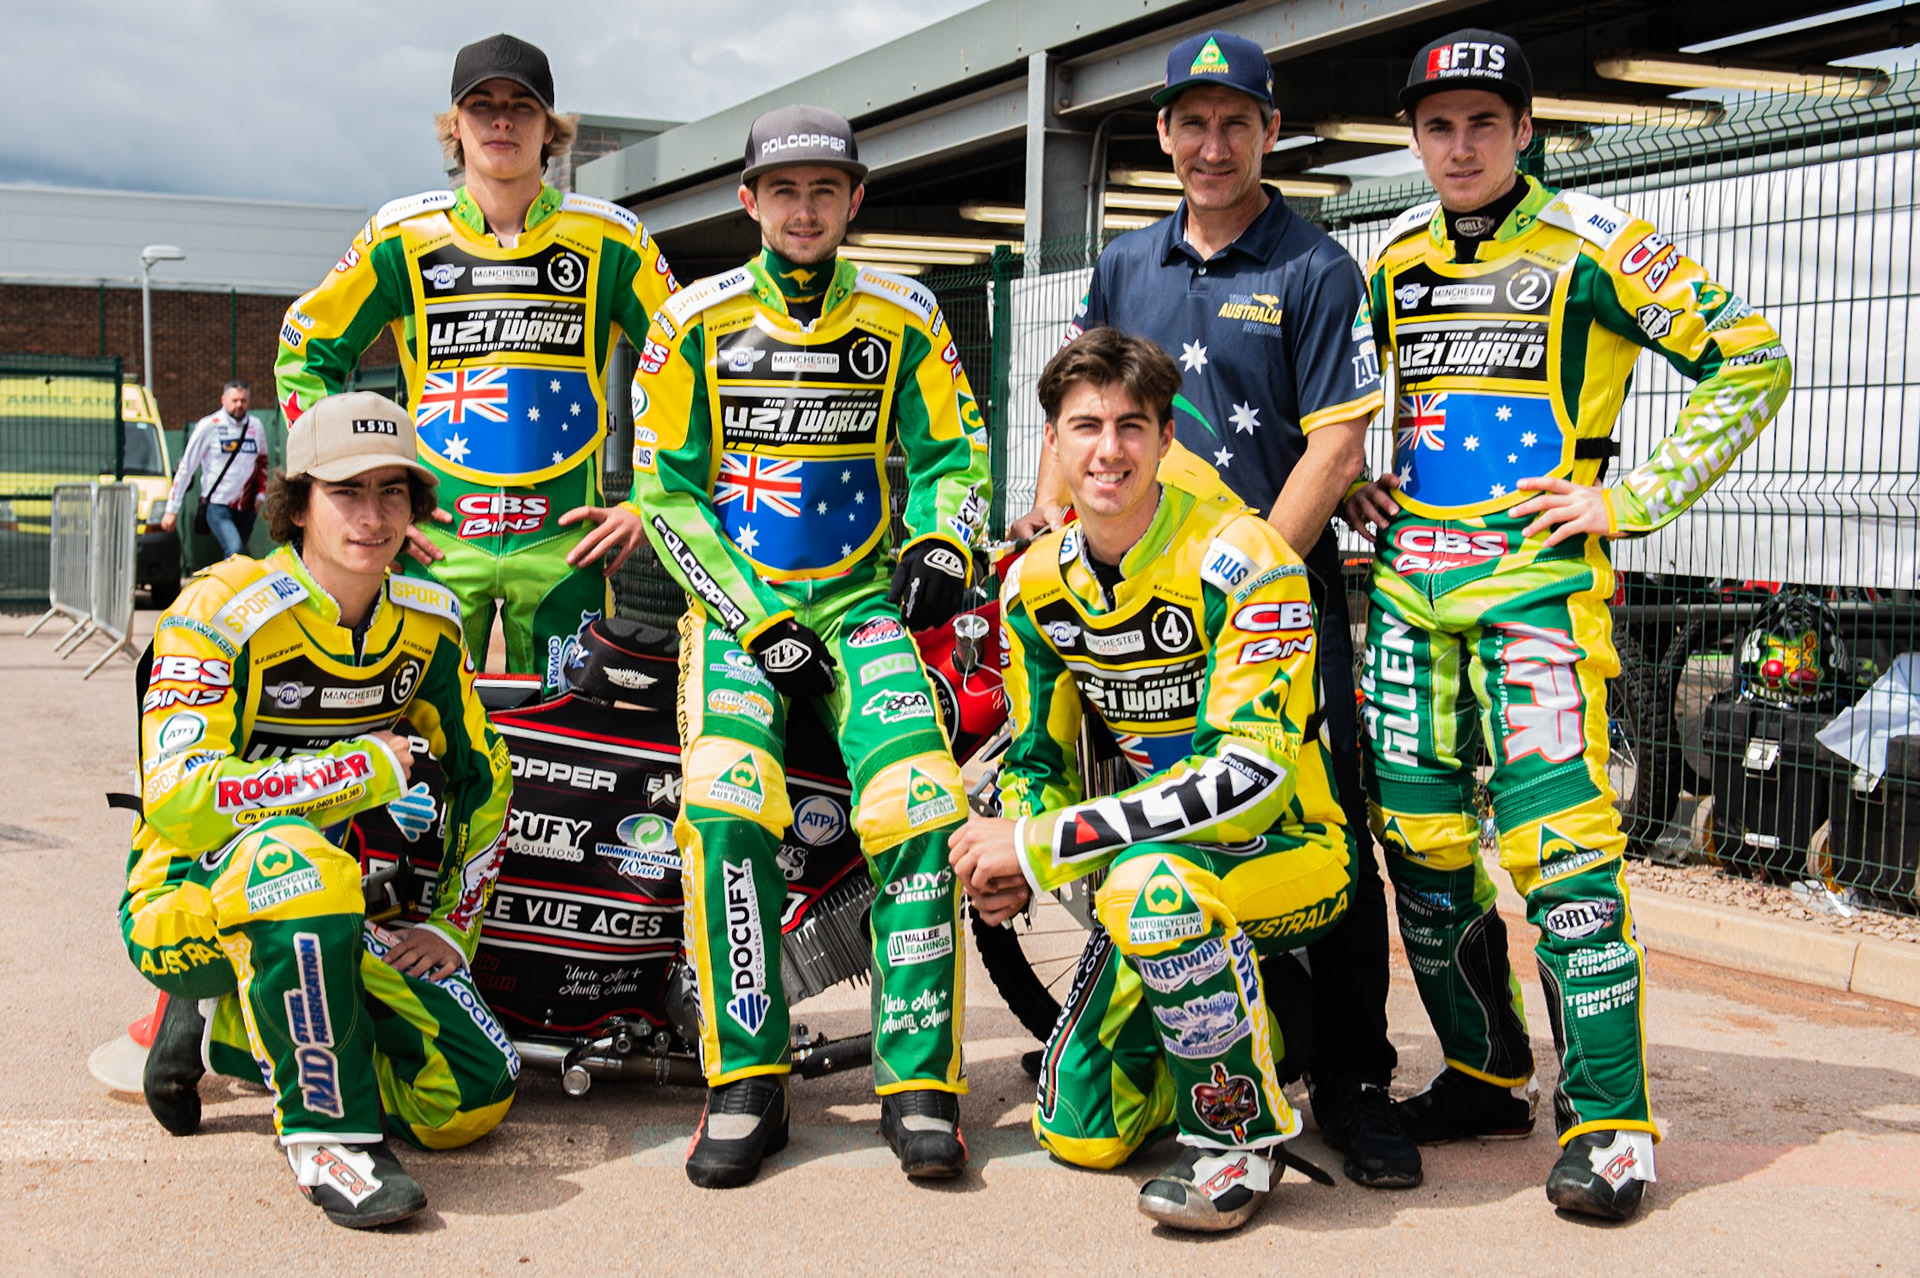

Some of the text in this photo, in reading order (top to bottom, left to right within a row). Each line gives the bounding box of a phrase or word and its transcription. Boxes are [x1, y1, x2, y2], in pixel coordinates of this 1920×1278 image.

[1452, 42, 1505, 71] FTS
[1439, 68, 1469, 78] Training
[1470, 67, 1503, 79] Services
[762, 134, 847, 157] POLCOPPER
[473, 269, 536, 278] MANCHESTER
[558, 258, 575, 286] 3
[1517, 274, 1539, 303] 2
[1218, 303, 1282, 325] AUSTRALIA
[430, 319, 583, 347] U21 WORLD
[774, 355, 837, 364] MANCHESTER
[861, 344, 874, 373] 1
[1399, 342, 1446, 368] U21
[1445, 341, 1545, 369] WORLD
[725, 406, 877, 434] U21 WORLD
[1645, 390, 1770, 524] KNIGHT
[458, 495, 548, 516] CBS
[461, 515, 541, 536] BINS
[1399, 530, 1505, 557] CBS
[655, 516, 746, 631] POLCOPPER
[1162, 613, 1183, 646] 4
[1233, 603, 1312, 631] CB
[549, 638, 559, 686] COWRA
[865, 656, 914, 680] DVR
[281, 690, 299, 701] FIM
[323, 686, 383, 701] MANCHESTER
[399, 668, 414, 697] 5
[1381, 611, 1419, 768] ALLEN
[219, 753, 369, 808] ROOF TILER
[1224, 755, 1269, 787] PROJECTS
[710, 789, 761, 813] AUSTRALIA
[508, 813, 589, 847] CUFY
[910, 805, 956, 827] AUSTRALIA
[513, 841, 583, 861] SOLUTIONS
[597, 843, 648, 861] WIMMERA
[619, 858, 664, 878] Waste
[248, 868, 319, 899] MOTORCYCLING
[249, 878, 323, 913] AUSTRALIA
[526, 899, 583, 929] VUE
[590, 909, 665, 938] ACES
[727, 868, 755, 990] DOCUFY
[1130, 914, 1203, 931] MOTORCYCLING
[905, 928, 940, 944] MALLEE
[906, 936, 951, 954] BEARINGS
[1131, 924, 1204, 943] AUSTRALIA
[1566, 951, 1637, 979] PLUMBING
[300, 939, 330, 1044] FABRICATION
[1566, 976, 1638, 1008] TANKARD
[1577, 991, 1635, 1018] DENTAL
